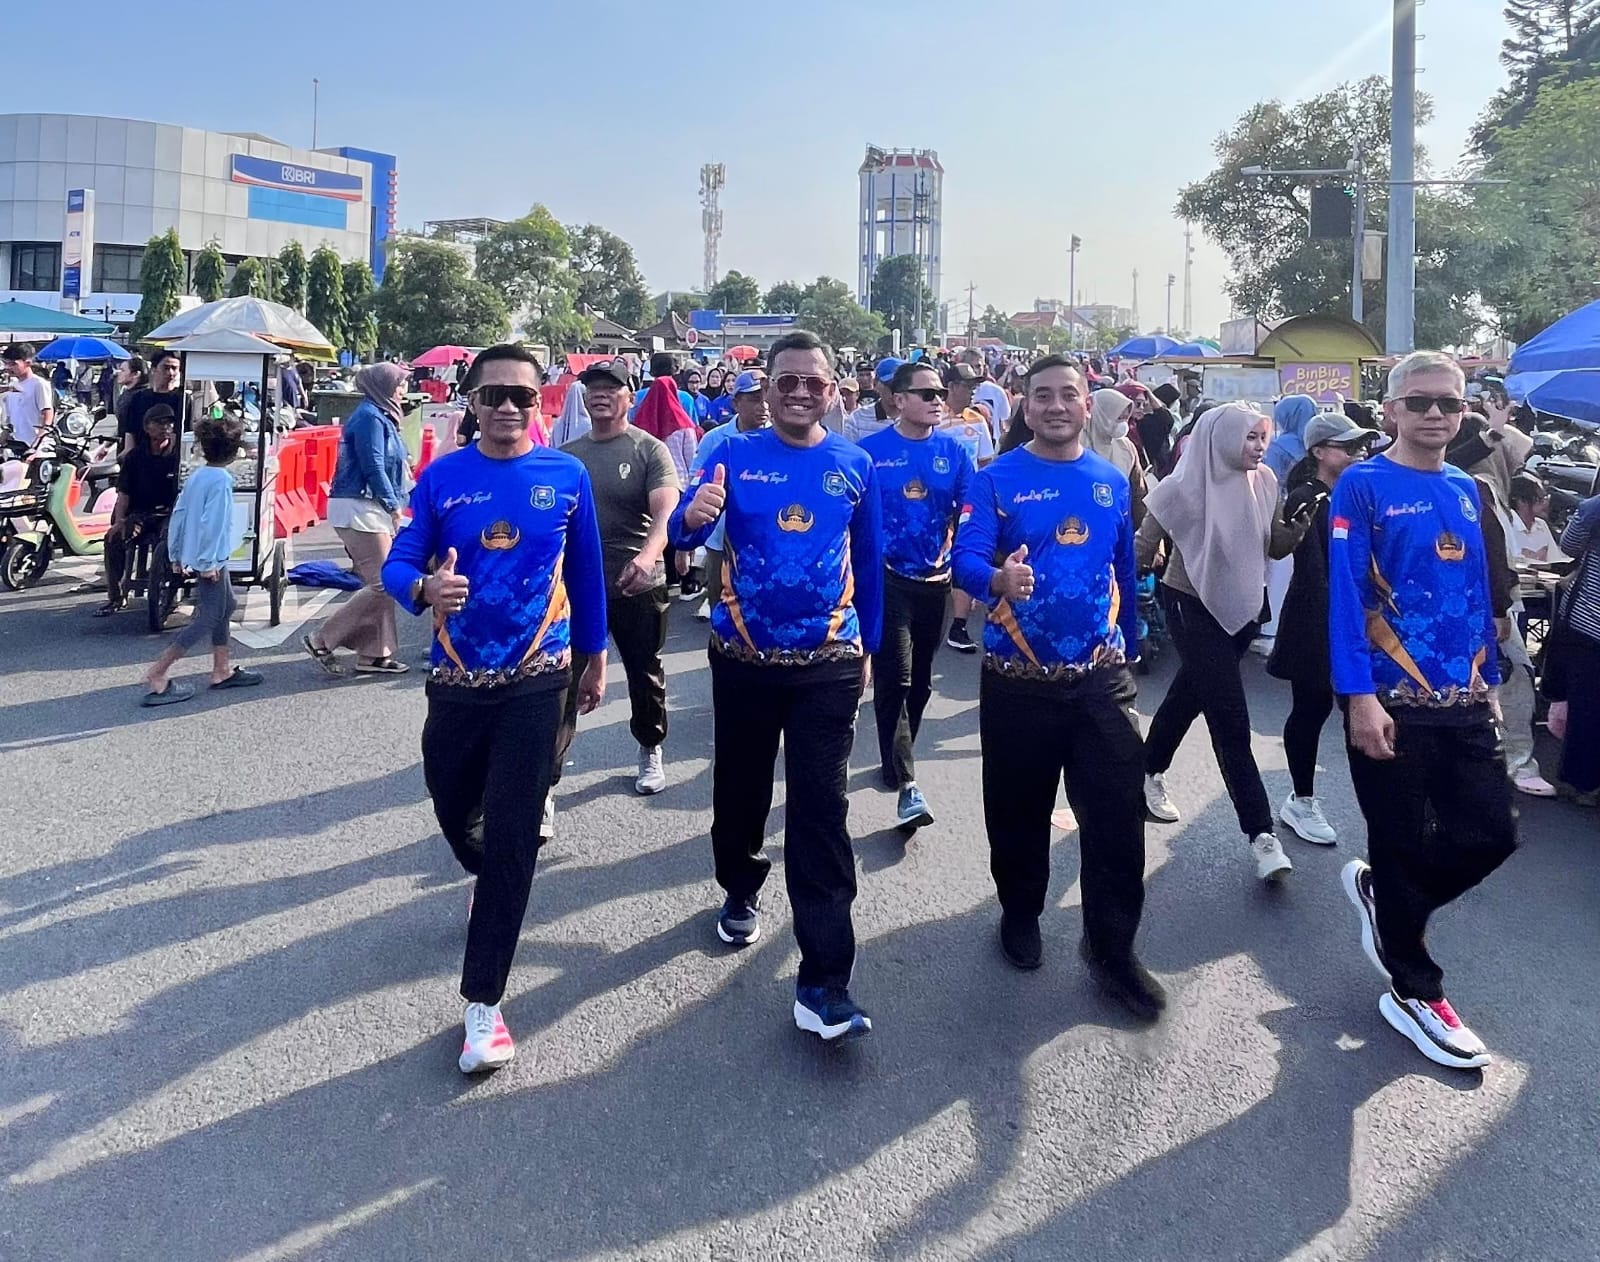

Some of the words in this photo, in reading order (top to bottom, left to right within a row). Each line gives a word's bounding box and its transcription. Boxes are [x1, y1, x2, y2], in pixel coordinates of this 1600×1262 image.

[296, 169, 315, 184] BRI
[1296, 366, 1341, 380] BinBin
[1282, 376, 1351, 396] Crepes
